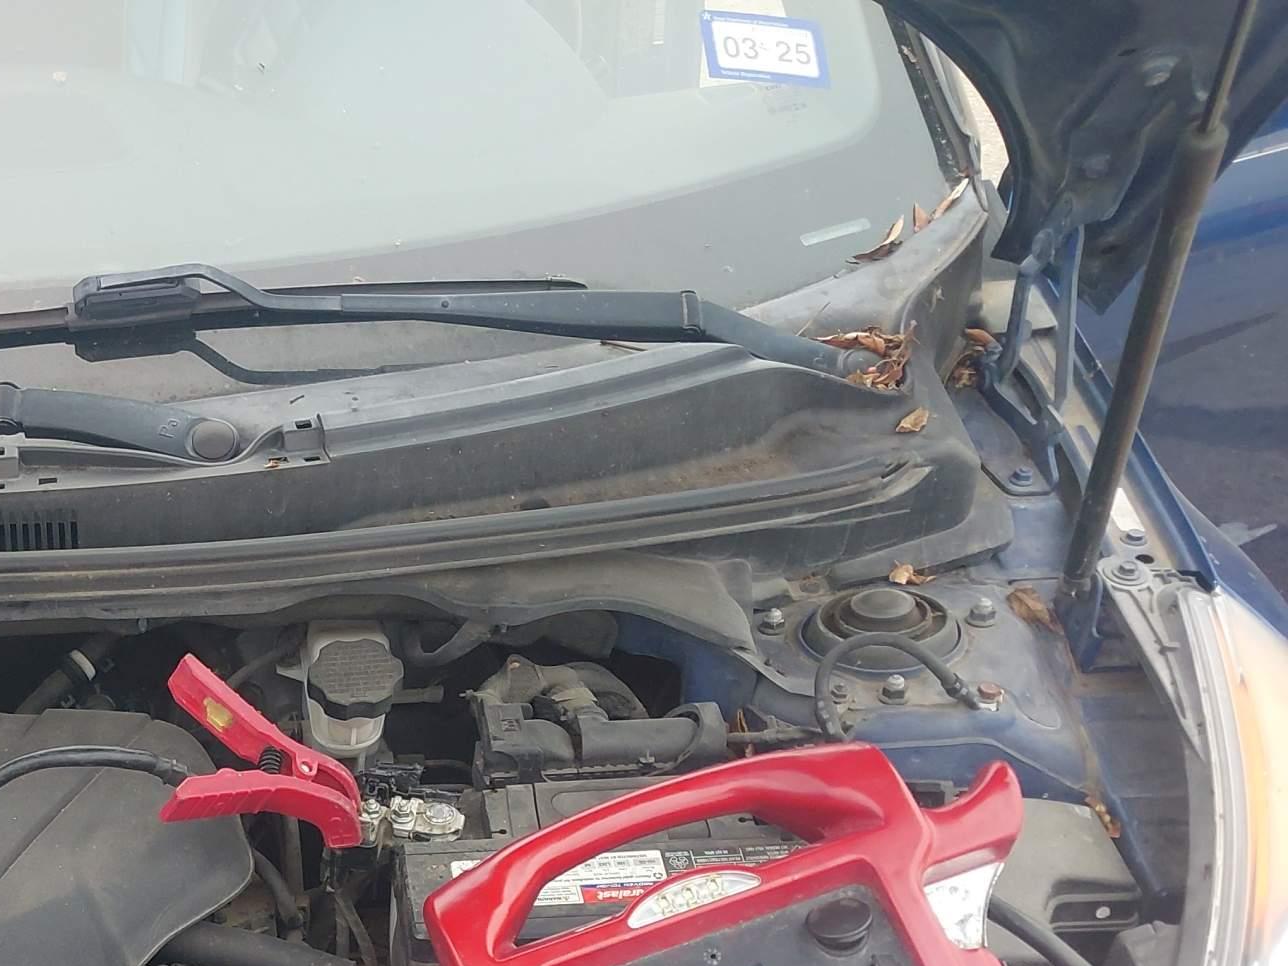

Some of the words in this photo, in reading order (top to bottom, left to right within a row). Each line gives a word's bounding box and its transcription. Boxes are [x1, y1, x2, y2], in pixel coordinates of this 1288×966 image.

[723, 36, 759, 60] 03
[775, 40, 812, 65] 25
[596, 888, 644, 901] uralast
